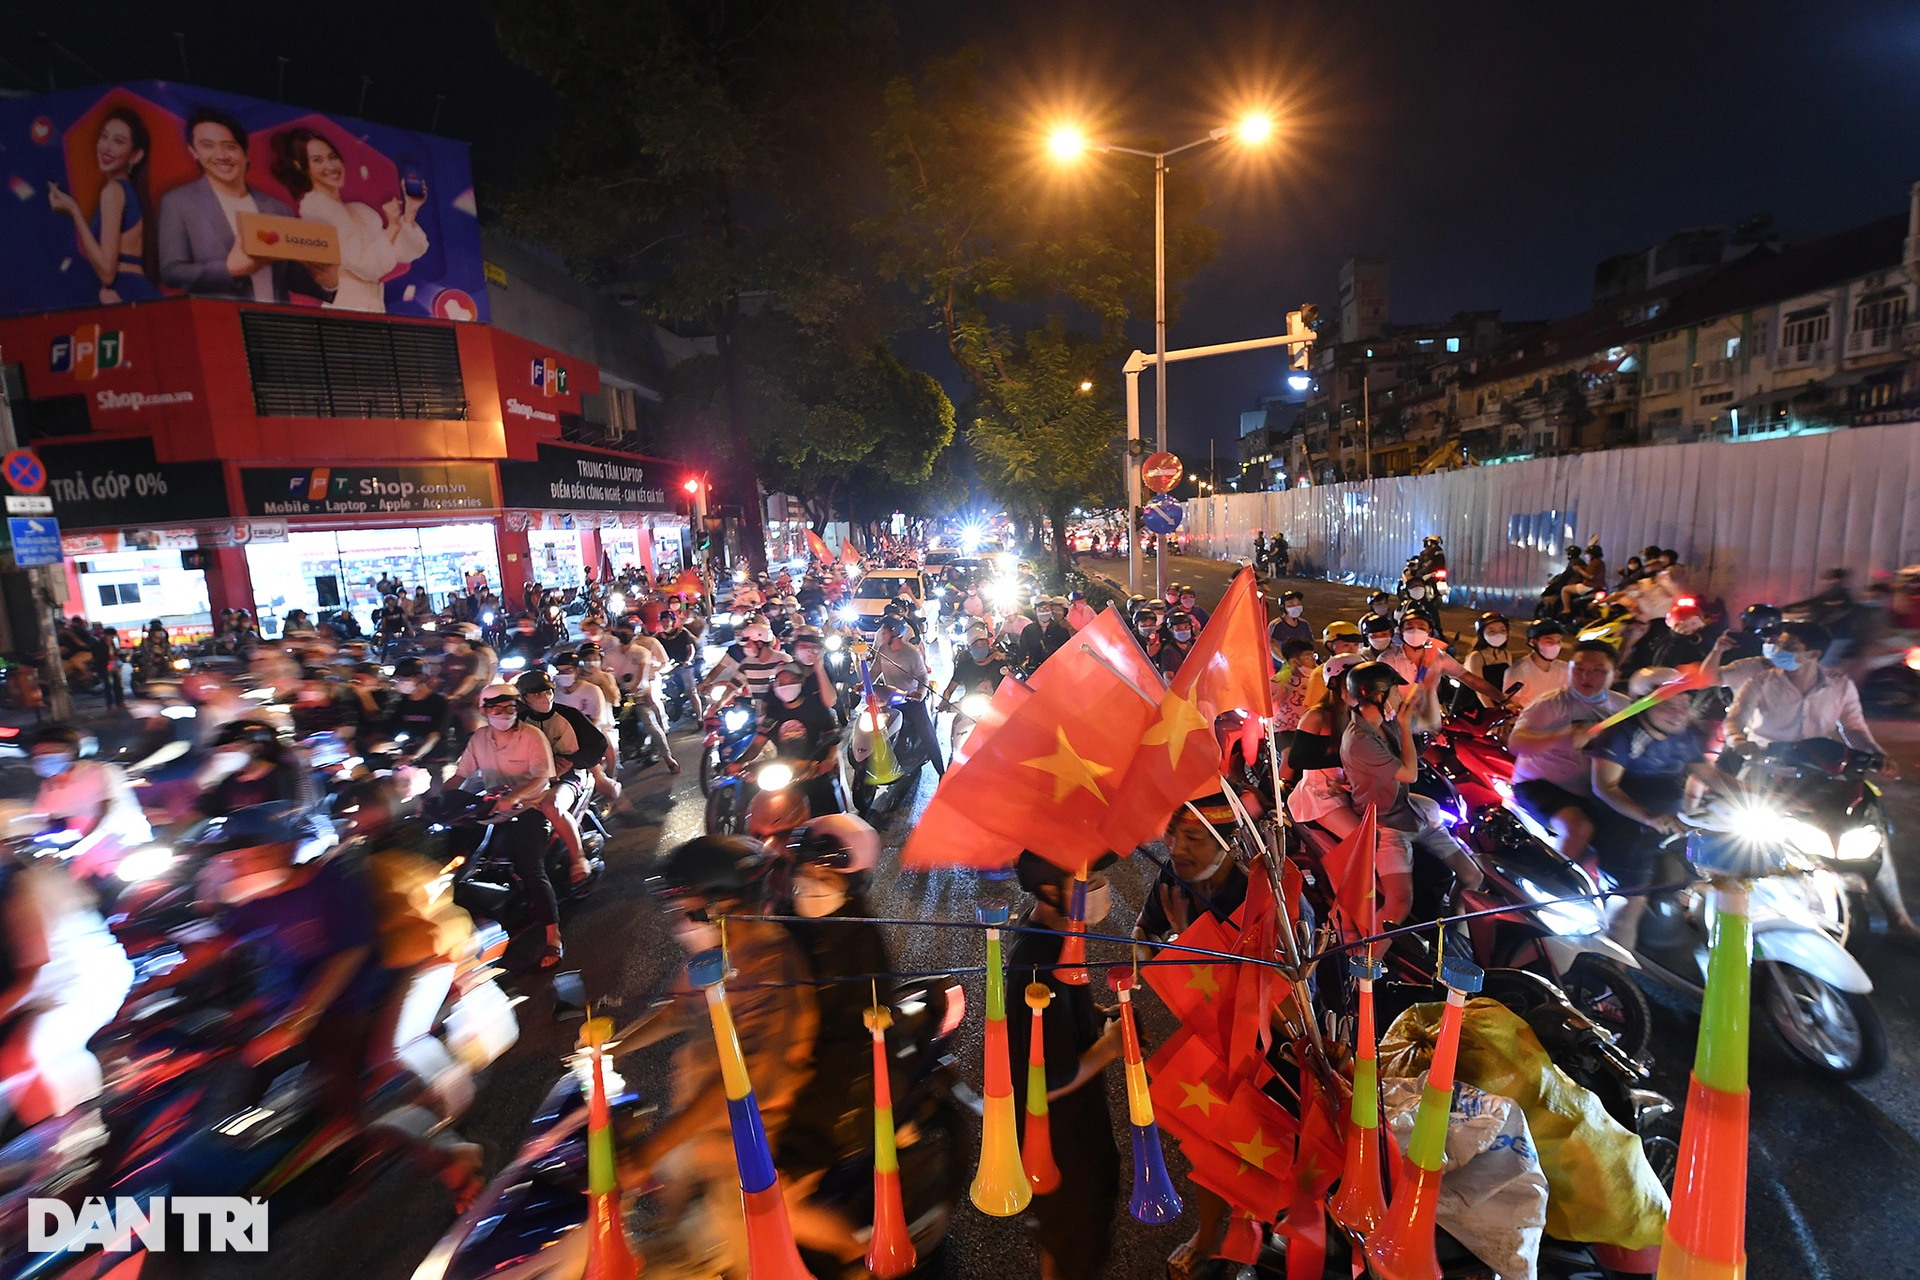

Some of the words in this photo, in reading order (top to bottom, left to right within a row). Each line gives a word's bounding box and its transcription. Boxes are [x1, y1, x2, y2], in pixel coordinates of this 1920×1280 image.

[285, 234, 329, 248] Lazada
[50, 335, 121, 367] FPT
[533, 363, 567, 389] FPT
[577, 460, 604, 479] TRUNG
[604, 461, 620, 480] TÂM
[620, 467, 643, 483] LAPTOP
[50, 470, 90, 502] TRẢ
[92, 470, 130, 499] GÓP
[135, 472, 168, 496] 0%
[264, 501, 310, 514] Mobile
[325, 500, 367, 513] Laptop
[379, 498, 411, 512] Apple
[423, 497, 482, 509] Accessories
[233, 524, 246, 540] 5
